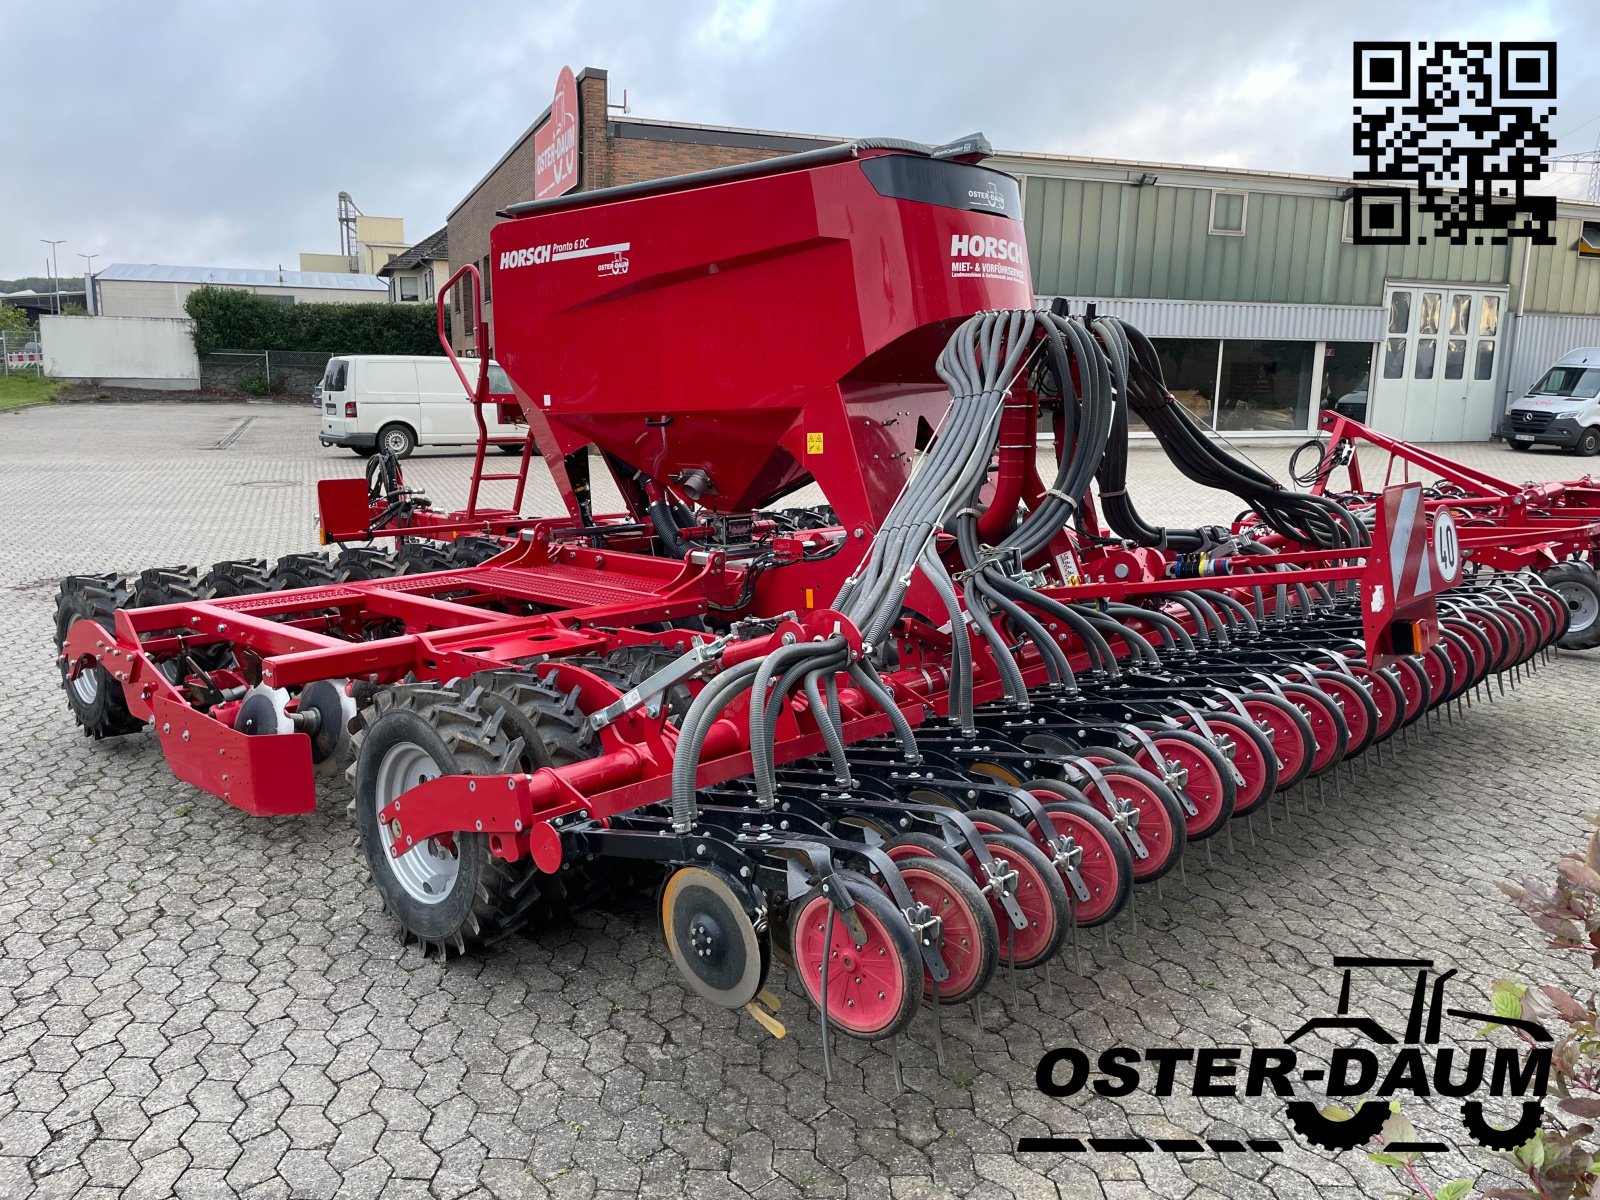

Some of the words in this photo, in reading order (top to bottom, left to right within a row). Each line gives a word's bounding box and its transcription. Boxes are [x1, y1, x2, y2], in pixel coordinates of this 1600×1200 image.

[537, 124, 575, 176] OSTER-DAUM
[968, 190, 1005, 203] OSTER-DAUM
[500, 244, 552, 270] HORSCH
[552, 241, 573, 253] Pronto
[574, 240, 579, 250] 6
[580, 237, 590, 249] DC
[950, 234, 1023, 265] HORSCH
[597, 261, 629, 272] OSTER-DAUM
[951, 262, 974, 272] MIET-
[974, 262, 981, 272] &
[982, 262, 1025, 280] VORFÜHRSERVICE
[1439, 525, 1455, 569] 40
